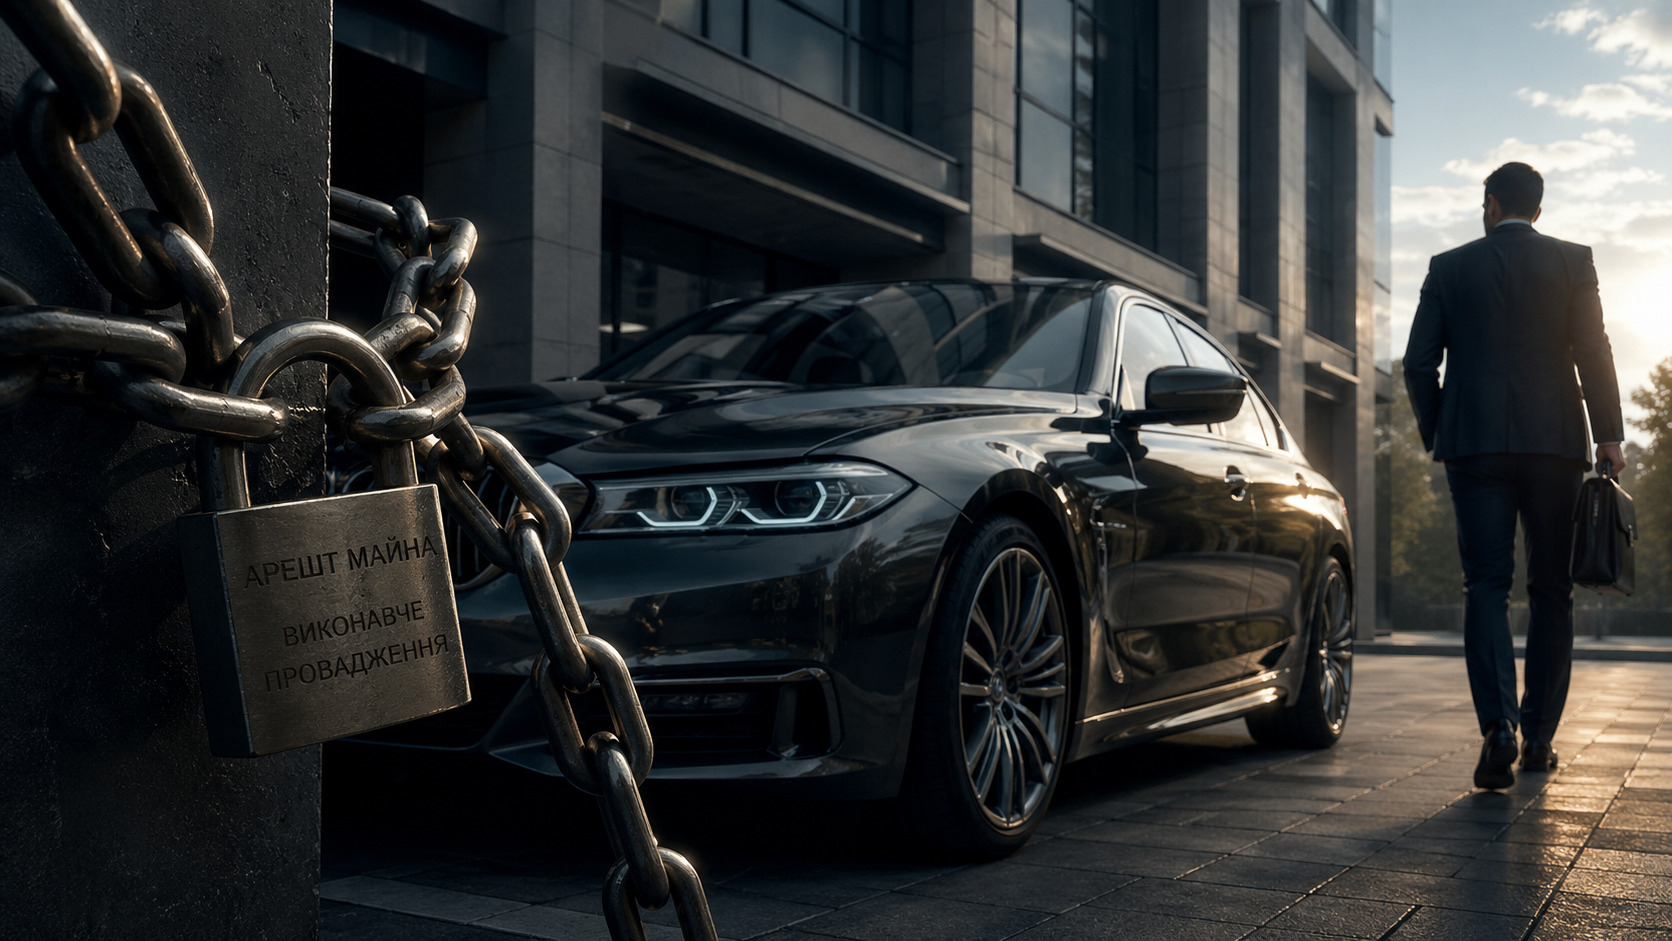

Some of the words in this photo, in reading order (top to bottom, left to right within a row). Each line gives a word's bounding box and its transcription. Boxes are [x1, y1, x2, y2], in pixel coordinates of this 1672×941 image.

[244, 552, 338, 588] АРЕШТ
[347, 536, 438, 570] МАЙНА
[283, 600, 425, 647] ВИКОНАВЧЕ
[265, 634, 448, 692] ПРОВАДЖЕННЯ
